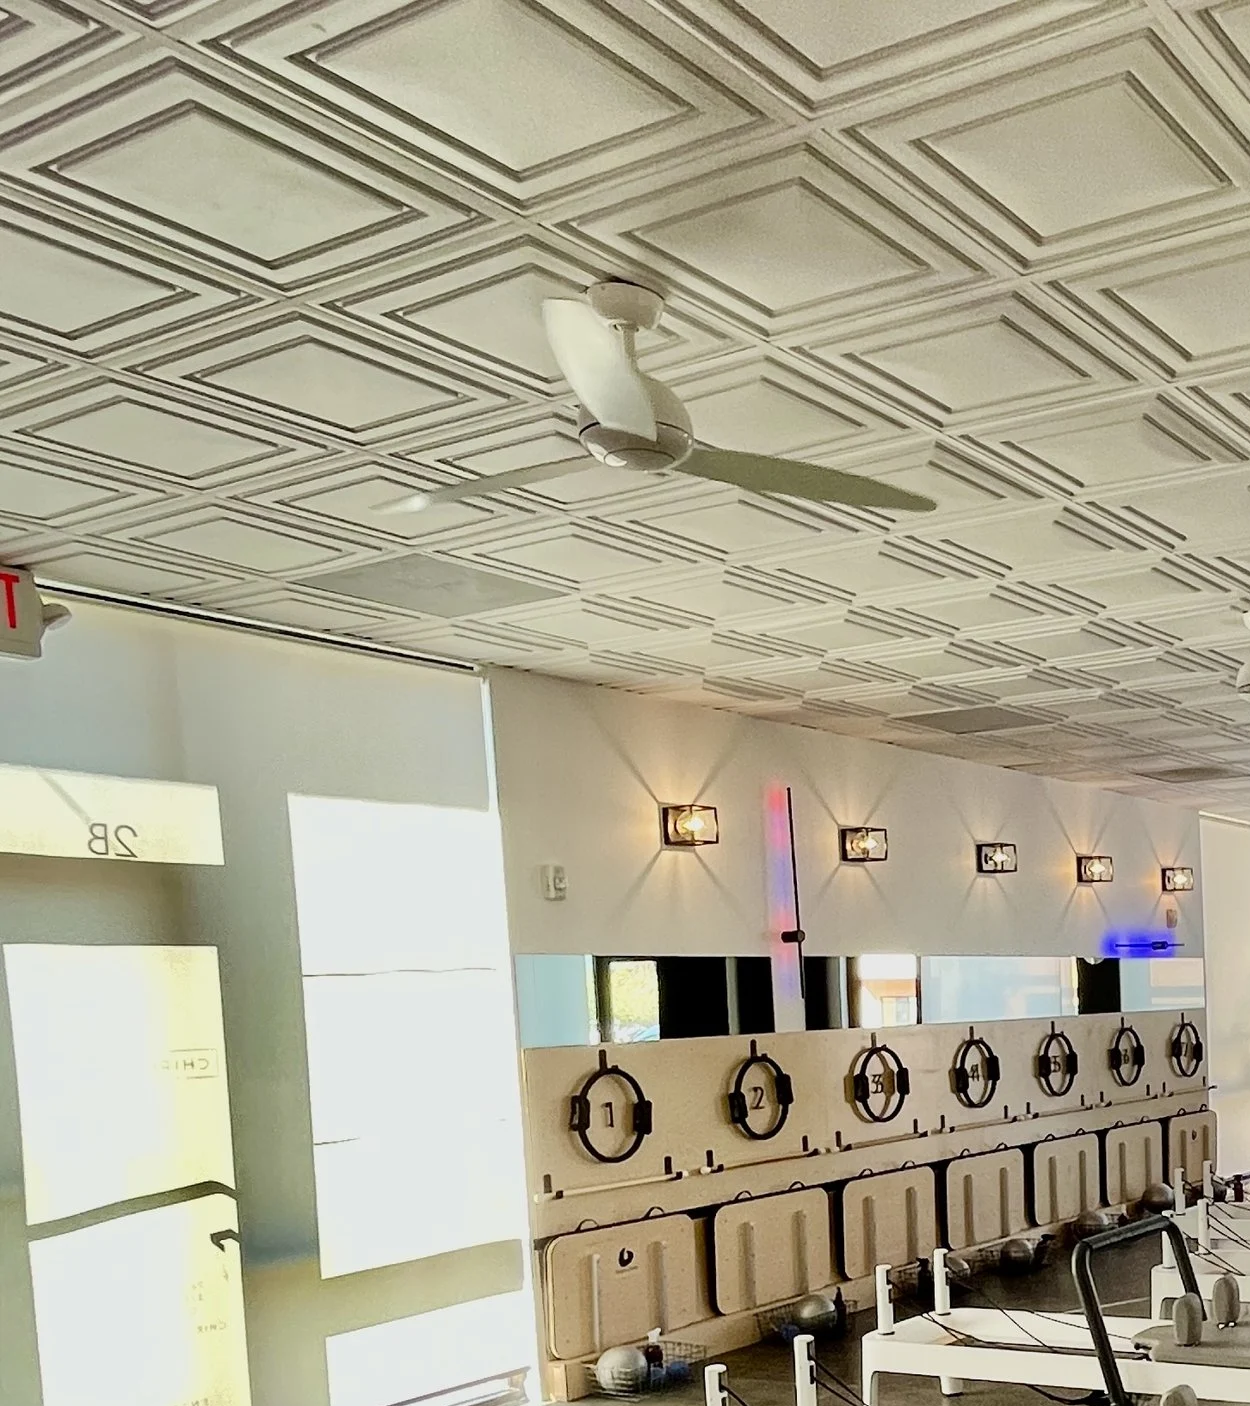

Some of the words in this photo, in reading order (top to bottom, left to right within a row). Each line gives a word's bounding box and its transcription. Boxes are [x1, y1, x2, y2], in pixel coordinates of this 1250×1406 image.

[968, 1063, 980, 1082] 4
[1050, 1055, 1062, 1073] 5
[871, 1074, 884, 1094] 3
[751, 1086, 765, 1110] 2
[602, 1101, 615, 1128] 1
